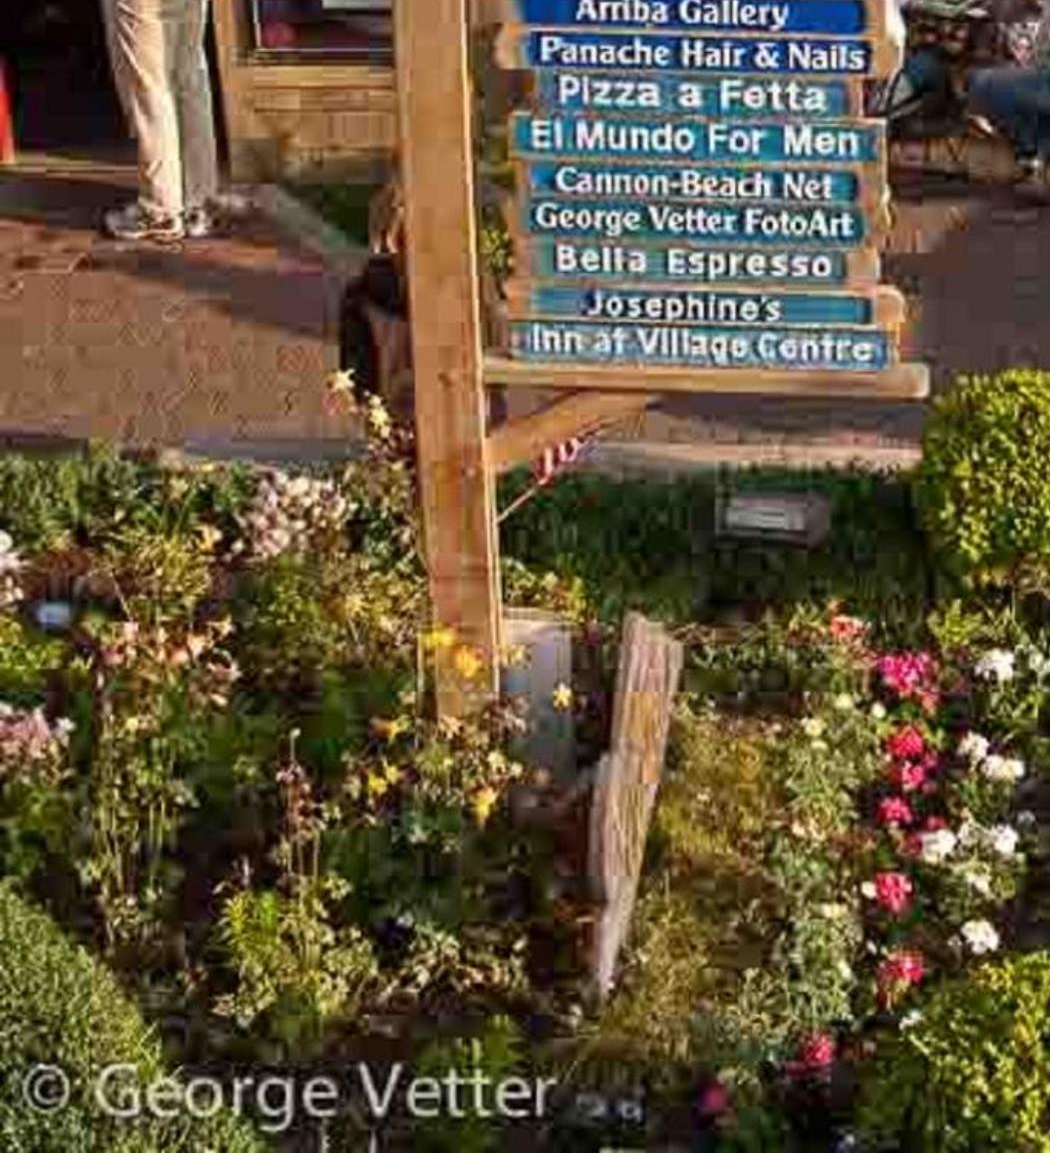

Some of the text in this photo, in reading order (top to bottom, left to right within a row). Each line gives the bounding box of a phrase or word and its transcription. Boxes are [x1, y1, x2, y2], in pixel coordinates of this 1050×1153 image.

[540, 36, 865, 71] Panache Hair & Nails
[558, 76, 827, 111] Pizza a Fetta
[531, 120, 859, 157] El Mundo For Men
[783, 172, 832, 199] Net
[535, 204, 854, 237] George Vetter FotoArt
[556, 247, 832, 280] Bella Espresso
[588, 294, 781, 322] Josephine's
[532, 327, 873, 362] Inn at Village Centre
